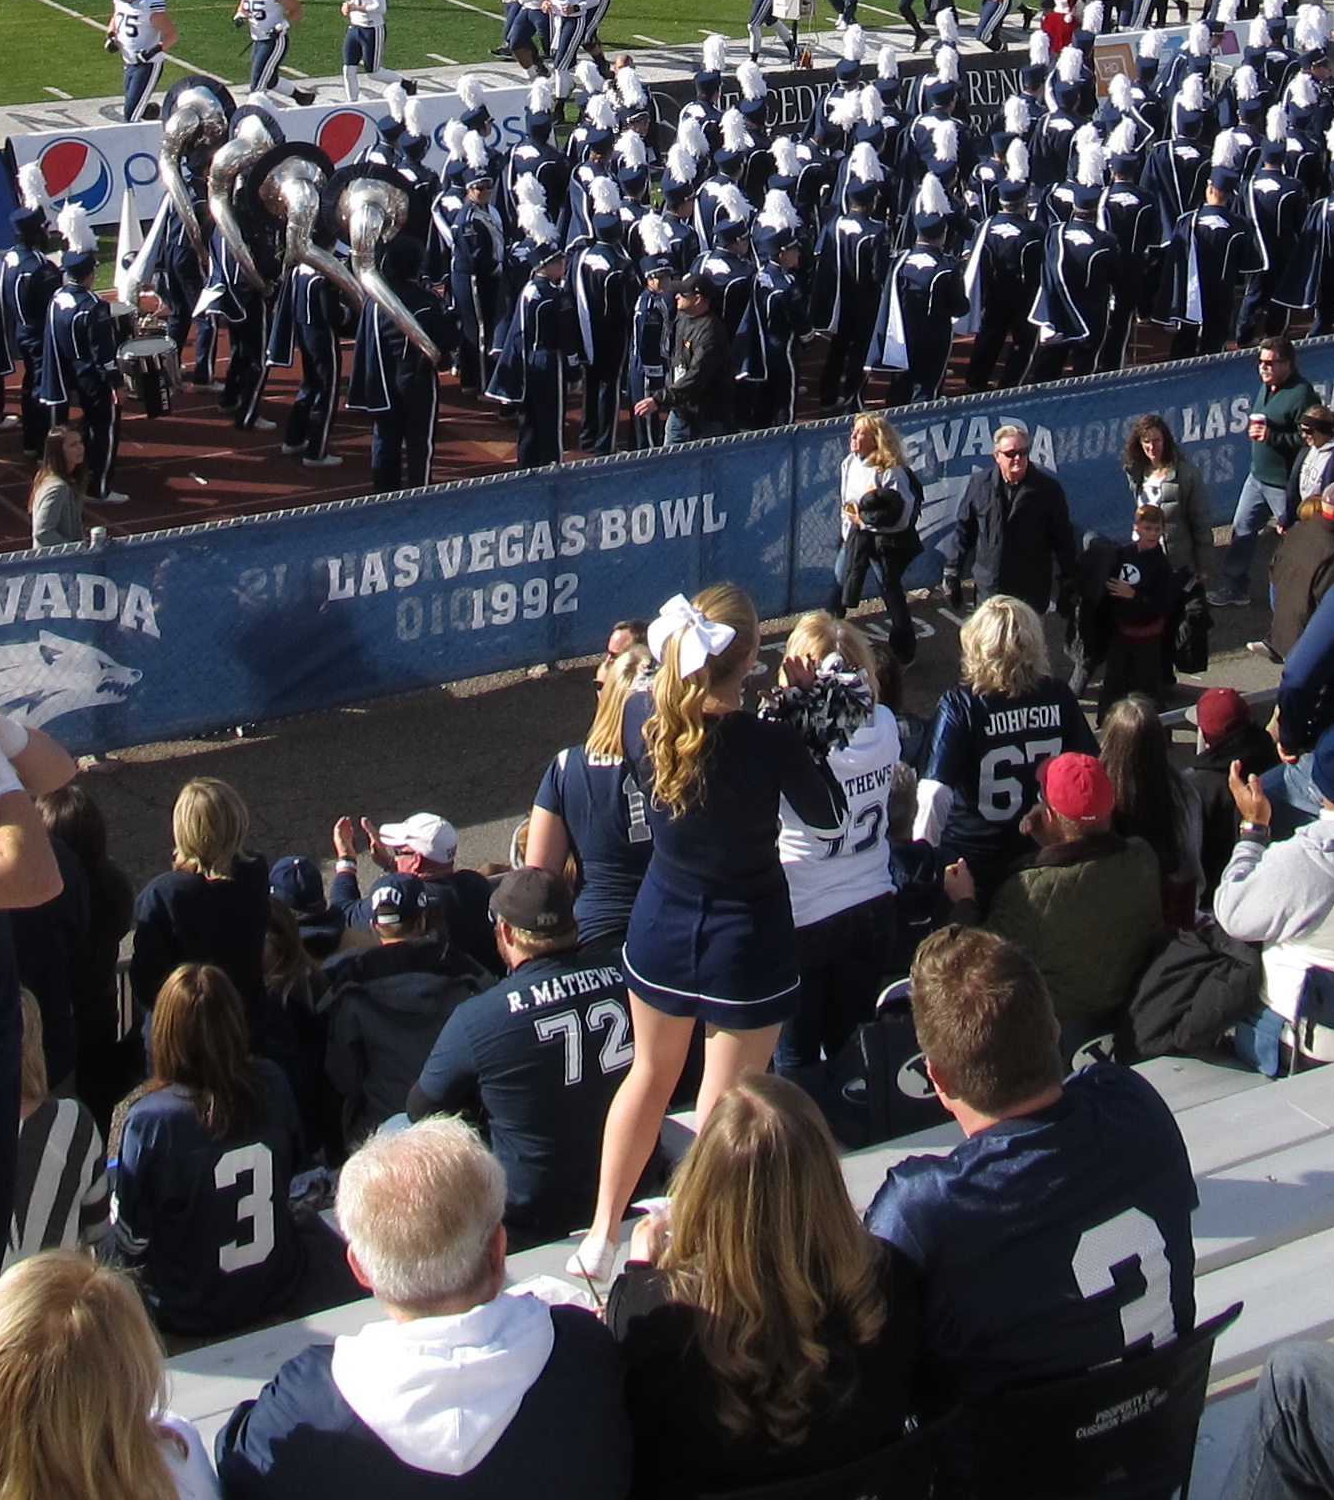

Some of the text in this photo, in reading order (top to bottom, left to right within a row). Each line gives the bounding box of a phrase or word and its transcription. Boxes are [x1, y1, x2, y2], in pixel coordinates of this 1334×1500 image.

[115, 12, 139, 38] 75
[1104, 61, 1119, 74] HD
[1181, 396, 1251, 445] LAS
[325, 491, 729, 600] LAS VEGAS BOWL
[1122, 564, 1137, 581] Y
[470, 573, 579, 630] 1992
[983, 702, 1062, 737] JOHNSON
[371, 885, 402, 911] BYU
[506, 964, 626, 1015] R. MATHEWS
[534, 997, 635, 1088] 72
[213, 1141, 276, 1274] 3
[1072, 1206, 1178, 1360] 3
[1075, 1413, 1119, 1441] CUSHION
[1094, 1392, 1144, 1424] PROPERTY
